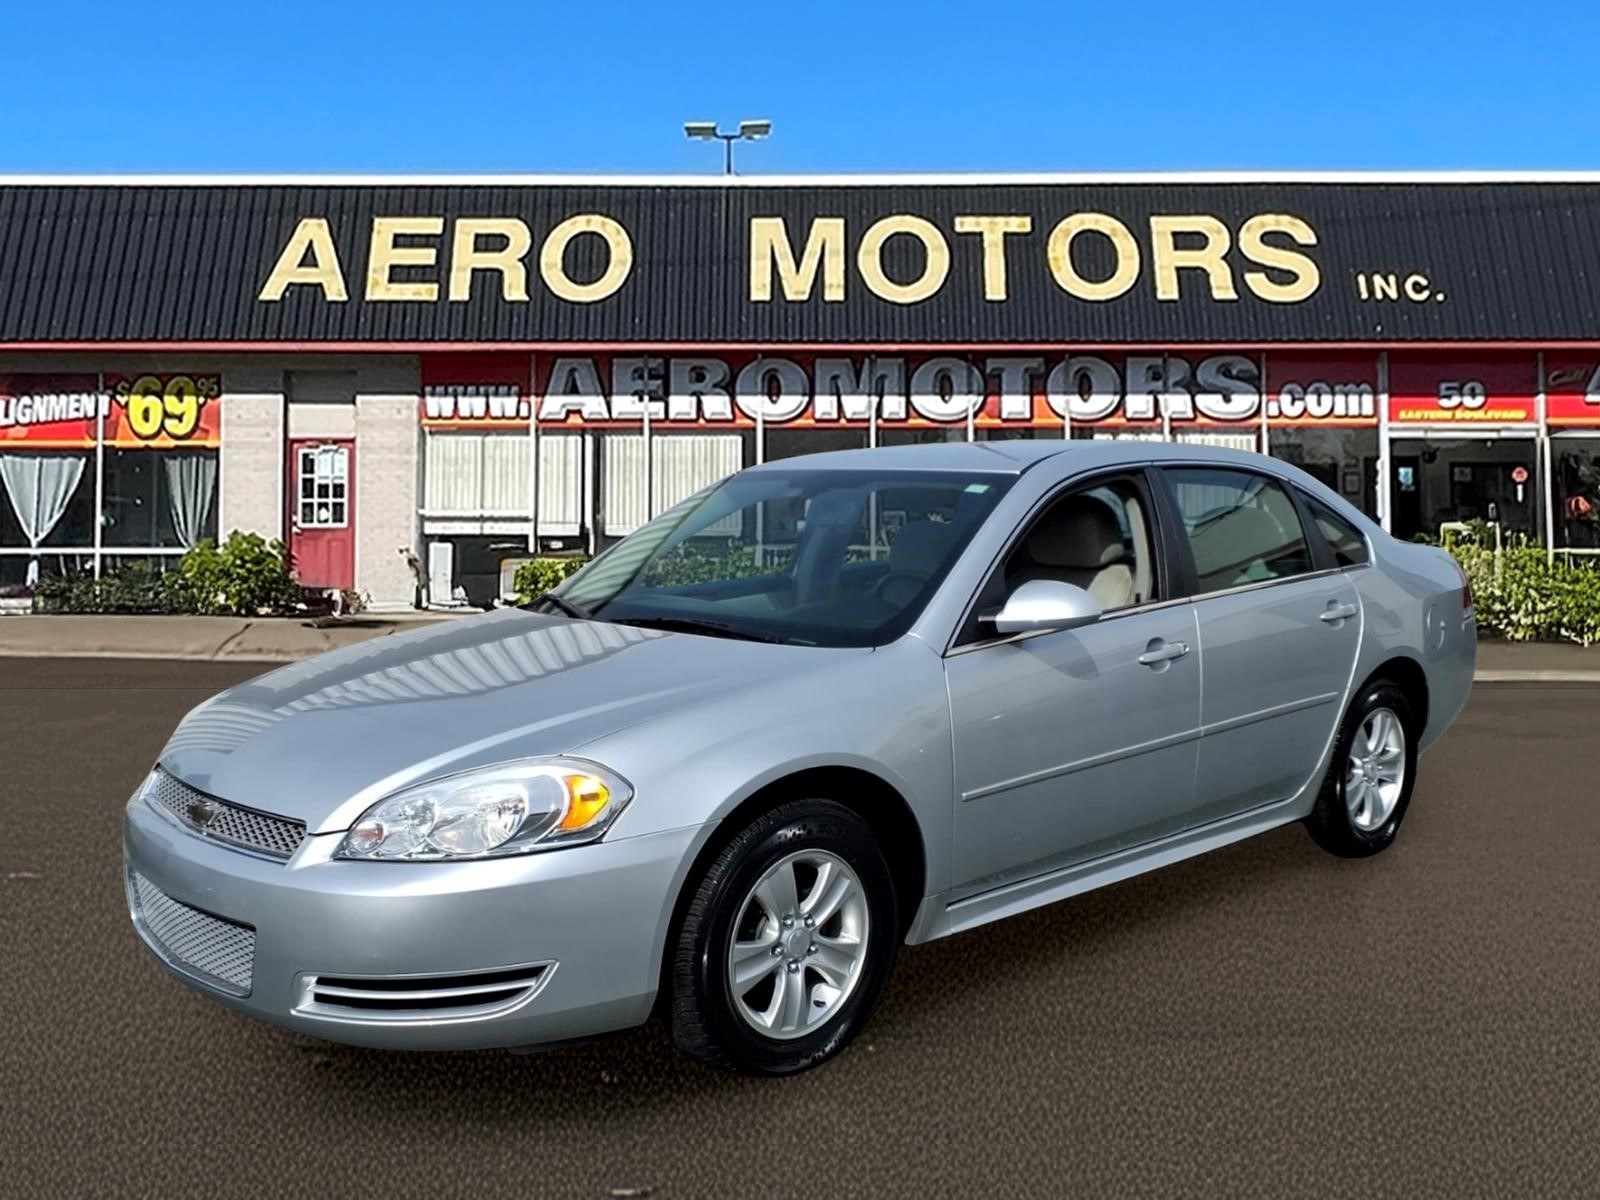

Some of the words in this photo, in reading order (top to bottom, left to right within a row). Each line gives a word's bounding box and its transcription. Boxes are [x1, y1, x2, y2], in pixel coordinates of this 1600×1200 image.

[257, 213, 634, 304] AERO
[749, 212, 1323, 305] MOTORS
[1356, 272, 1447, 302] INC.
[1437, 381, 1486, 408] 50
[1455, 407, 1528, 421] BOULEVARD
